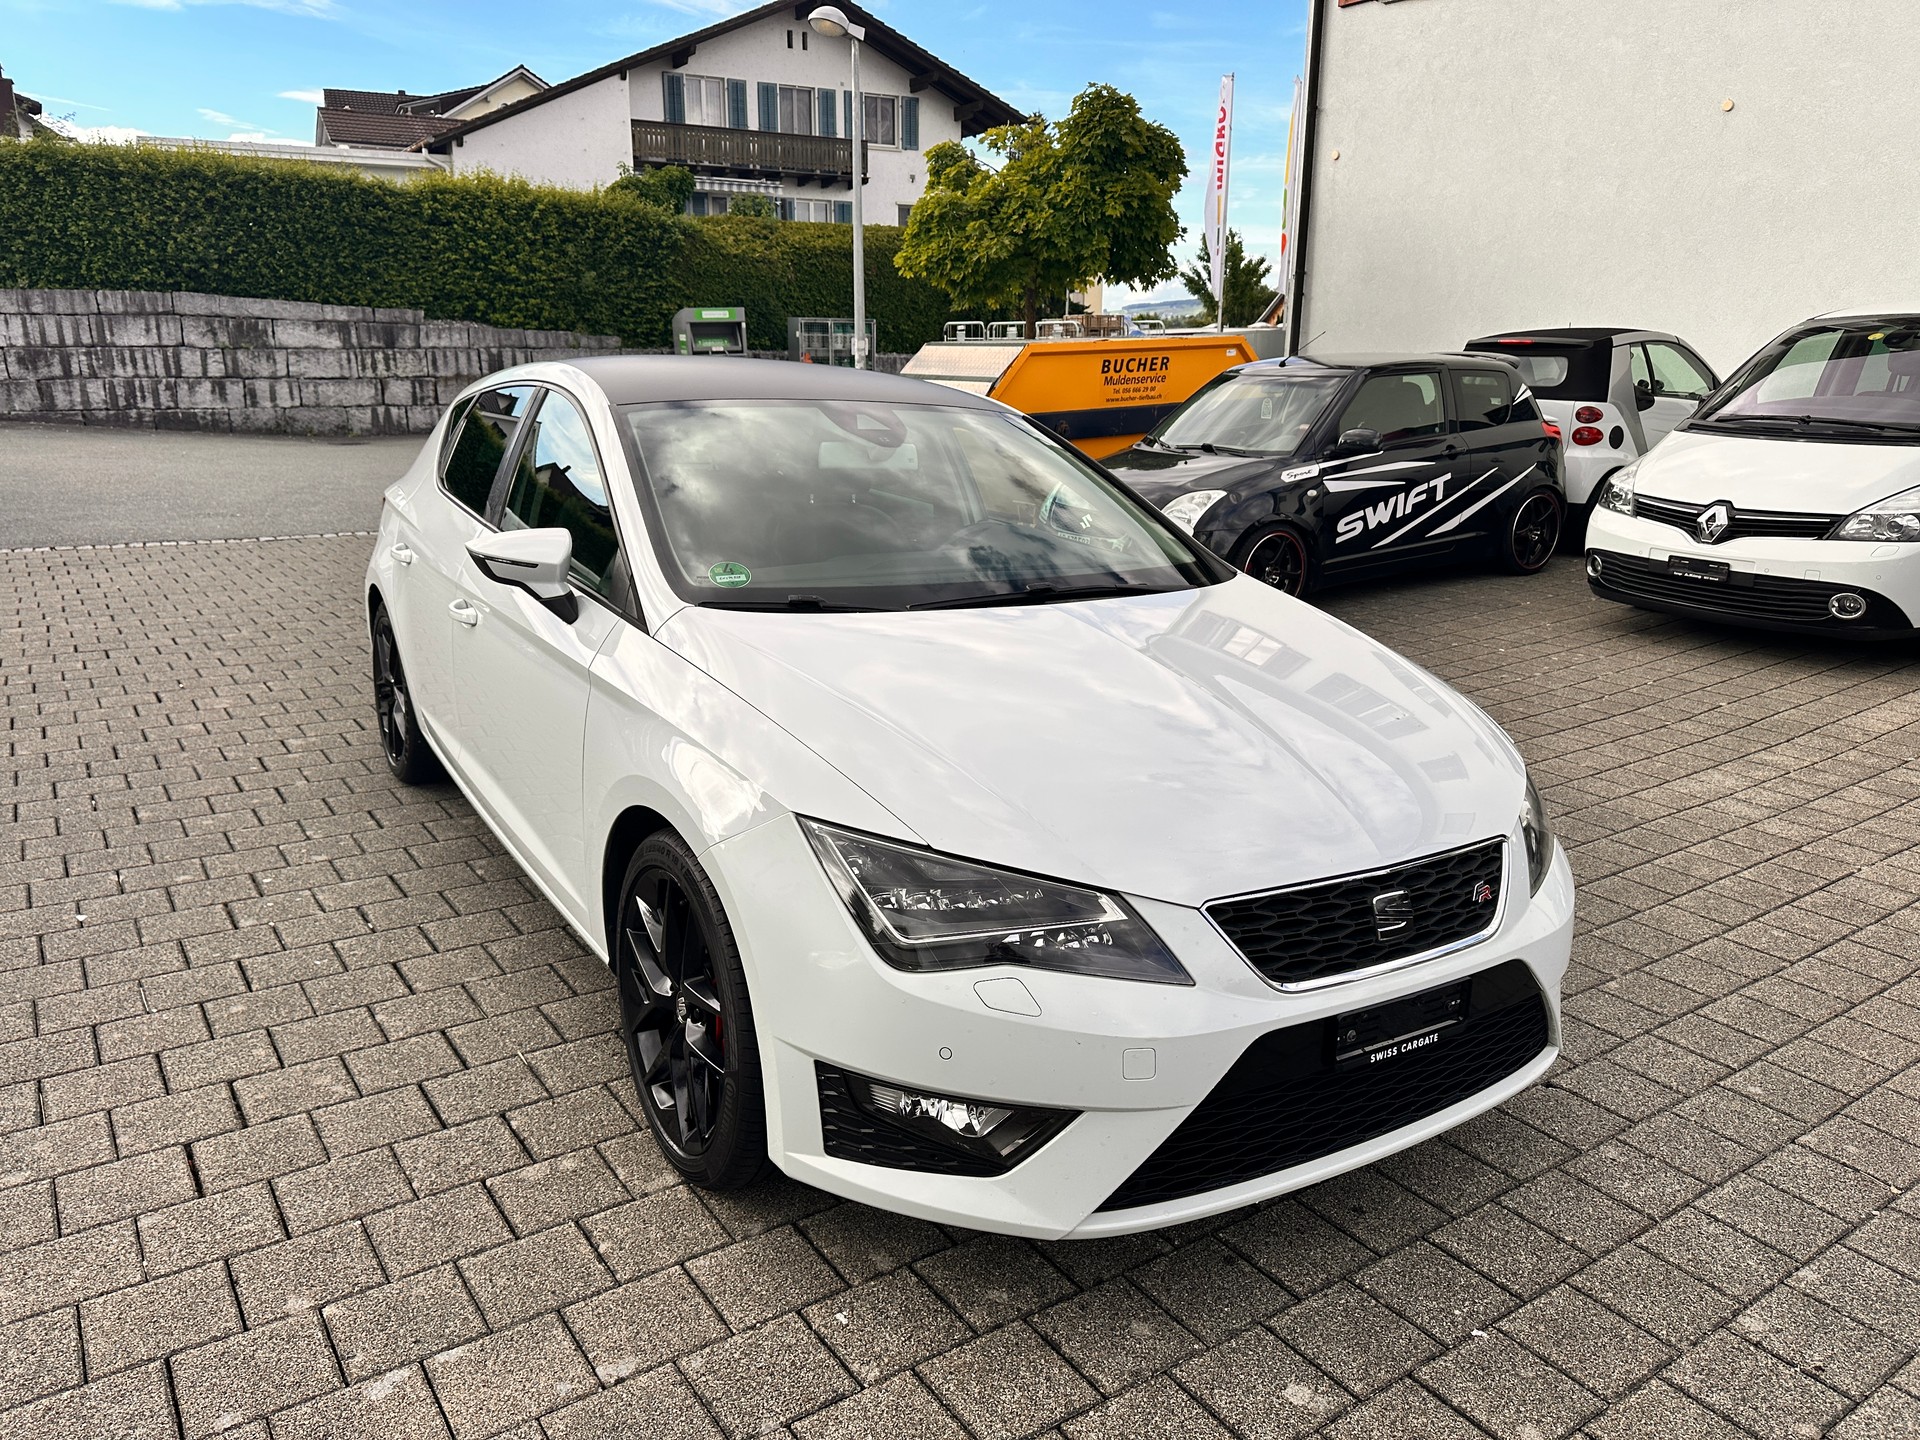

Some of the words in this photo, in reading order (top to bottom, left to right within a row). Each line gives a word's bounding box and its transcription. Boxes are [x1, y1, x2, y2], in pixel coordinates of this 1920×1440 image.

[1215, 106, 1227, 190] MIGRO
[1101, 356, 1170, 374] BUCHER
[1103, 373, 1167, 386] Muldenservice
[1286, 469, 1314, 480] Sport
[1335, 472, 1452, 544] SWIFT
[1472, 880, 1492, 903] FR
[1370, 1046, 1398, 1063] SWISS
[1401, 1033, 1439, 1053] CARGATE
